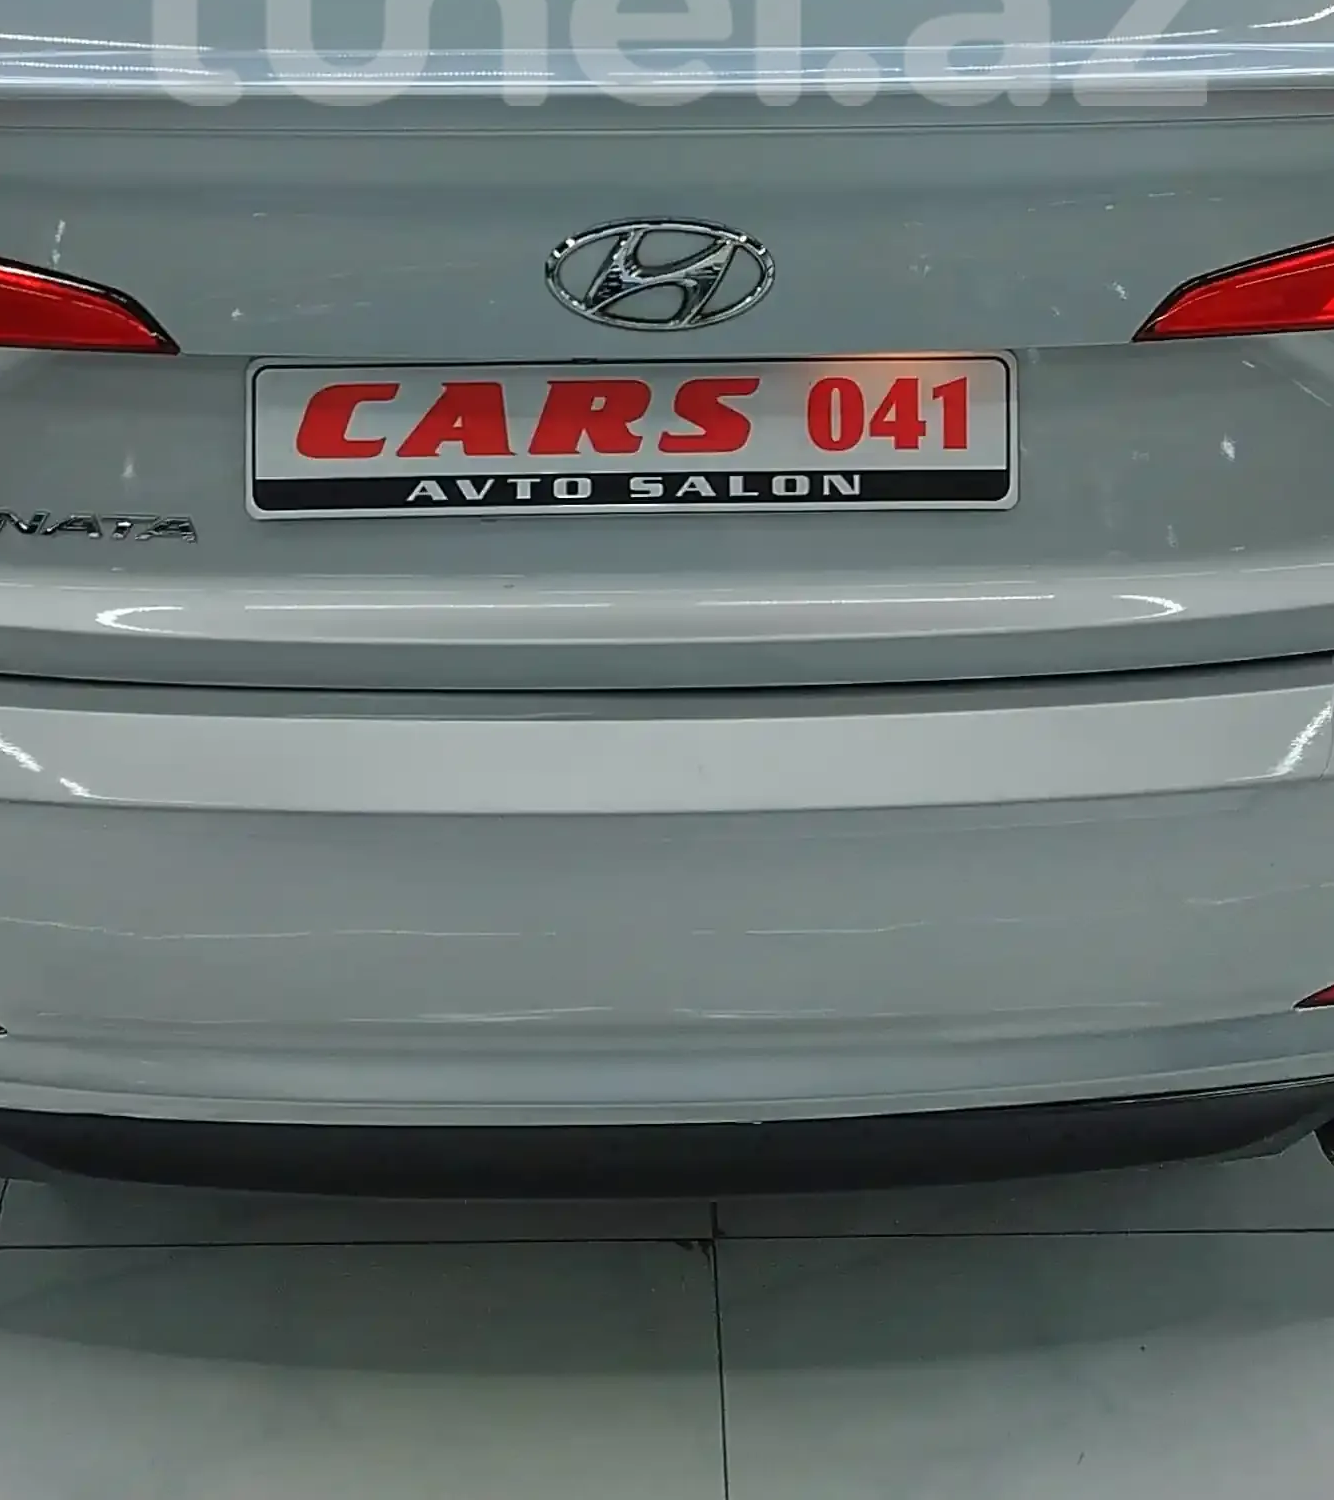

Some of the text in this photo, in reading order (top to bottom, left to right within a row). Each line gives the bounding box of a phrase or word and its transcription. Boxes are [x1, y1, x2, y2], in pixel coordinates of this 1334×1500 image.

[295, 376, 969, 459] CARS 041
[405, 473, 862, 502] AVTO SALON
